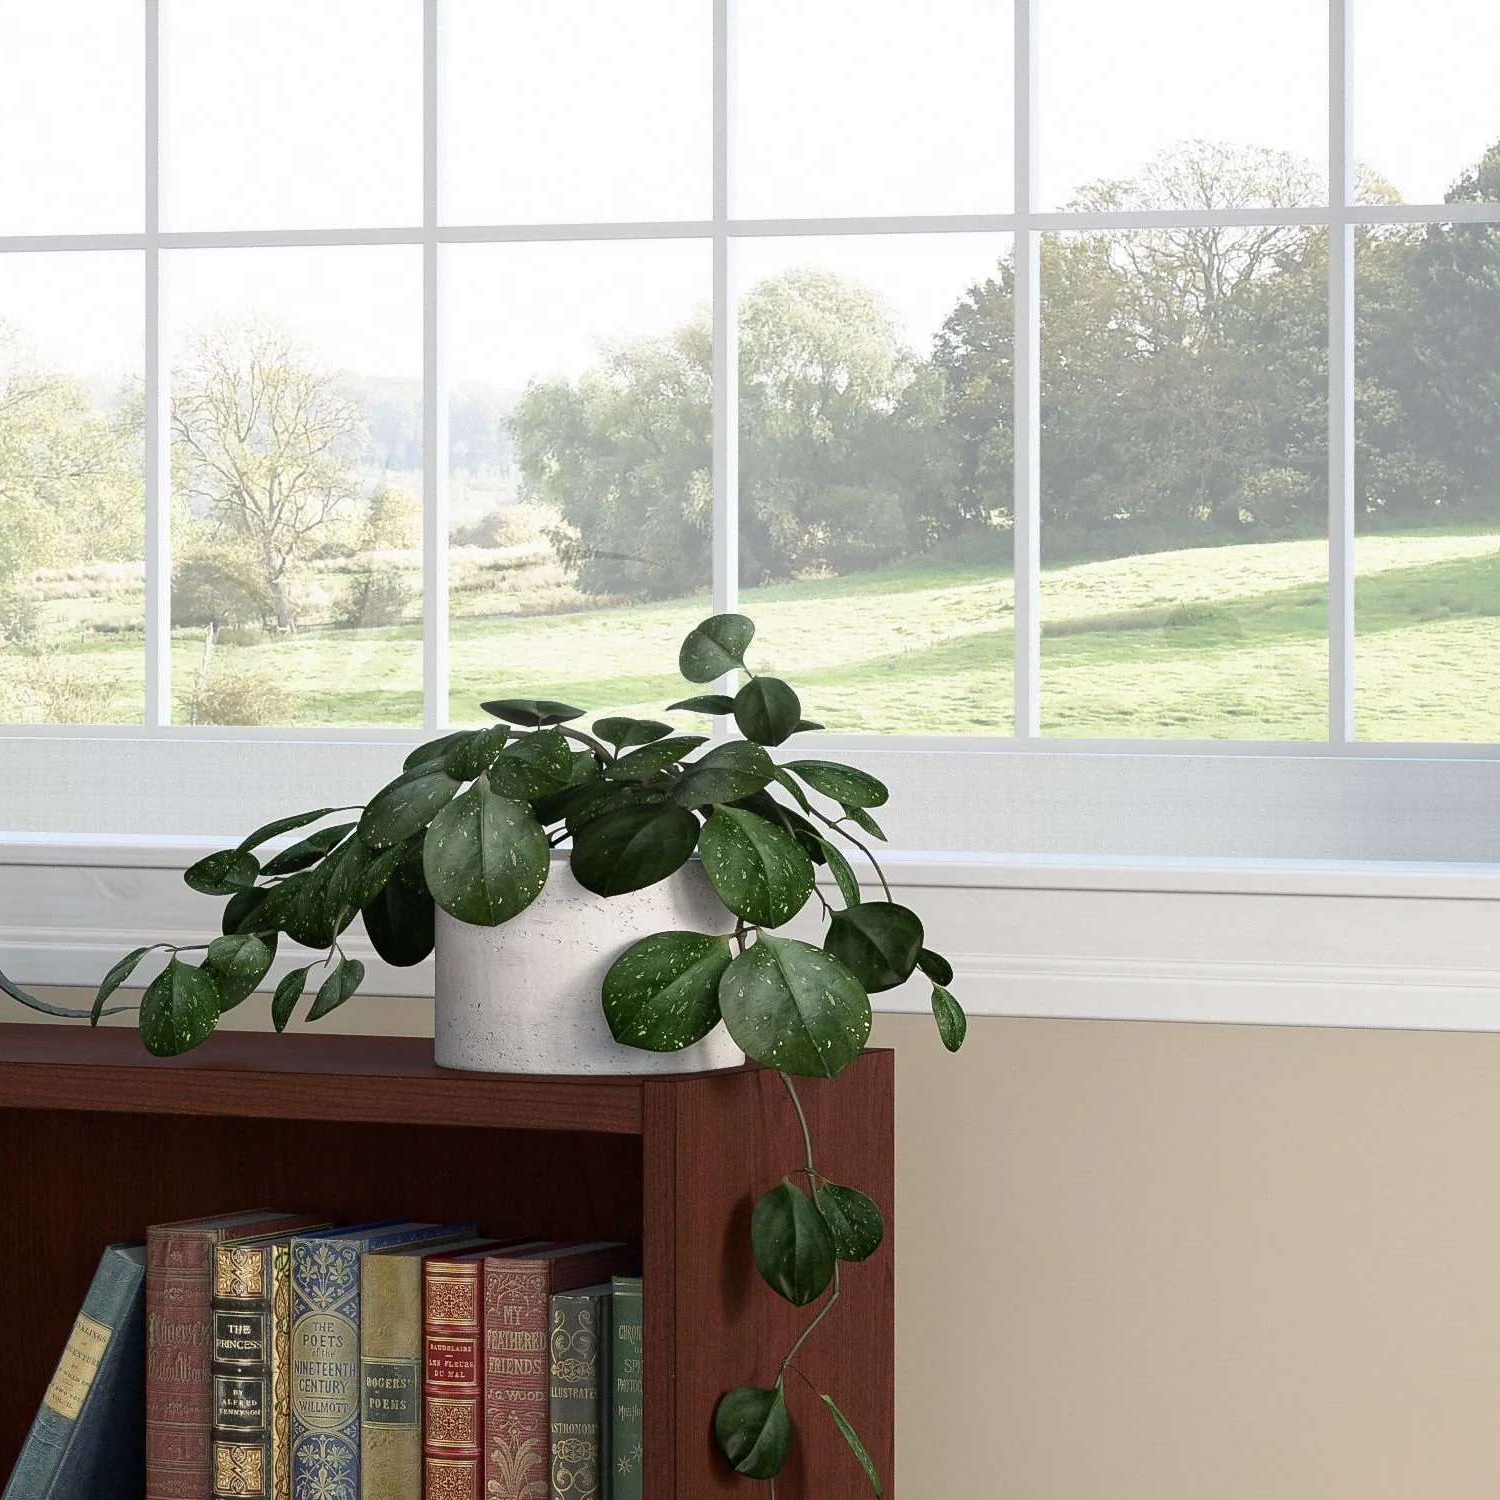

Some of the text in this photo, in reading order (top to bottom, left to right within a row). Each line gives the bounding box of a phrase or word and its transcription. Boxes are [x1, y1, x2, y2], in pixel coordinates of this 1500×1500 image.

[503, 1305, 522, 1325] MY
[227, 1324, 252, 1335] THE
[313, 1322, 335, 1333] THE
[216, 1339, 262, 1350] PRINCESS
[303, 1334, 344, 1348] POETS
[486, 1328, 547, 1351] FEATHERED
[311, 1348, 335, 1358] of the
[430, 1343, 472, 1353] BAUDELAIRE
[294, 1360, 357, 1378] NINETEENTH
[429, 1359, 474, 1368] LES FLEURS
[447, 1370, 466, 1378] MAL
[299, 1379, 349, 1395] CENTURY
[366, 1376, 411, 1389] ROGERS'
[233, 1389, 244, 1397] BY
[221, 1398, 258, 1408] ALFRED
[299, 1400, 349, 1414] WILLMOTT
[369, 1397, 407, 1410] POEMS
[219, 1408, 261, 1417] TENNYSON
